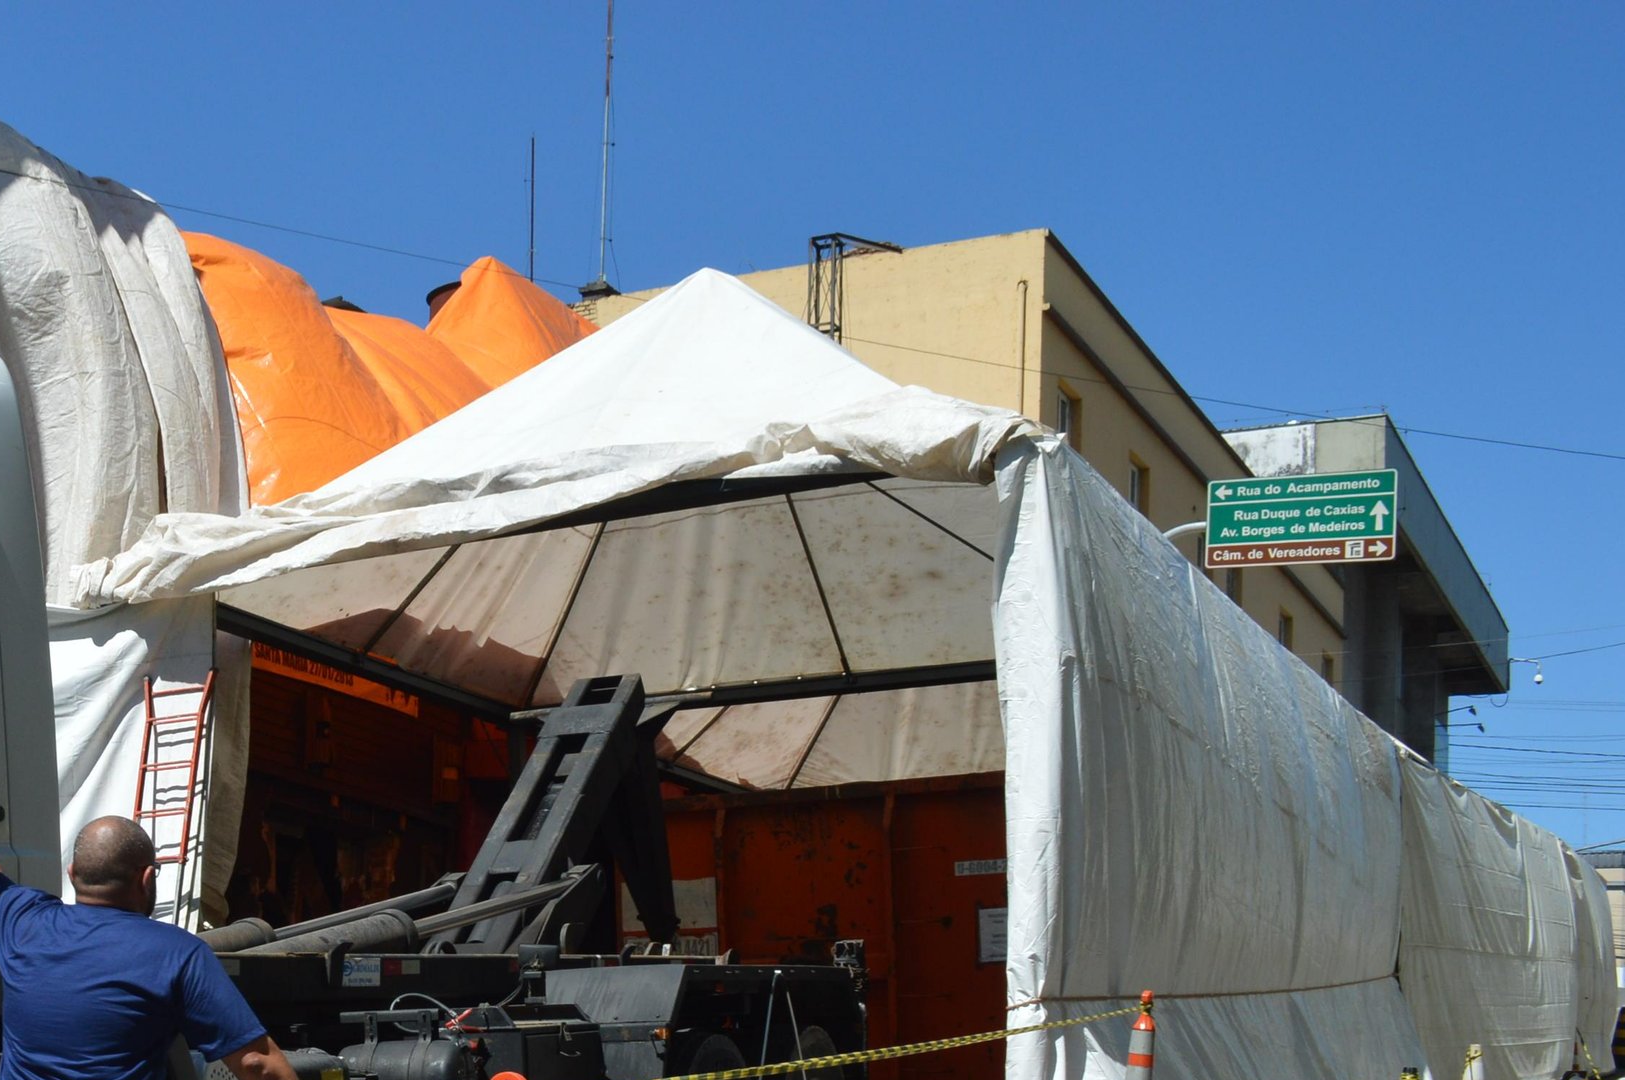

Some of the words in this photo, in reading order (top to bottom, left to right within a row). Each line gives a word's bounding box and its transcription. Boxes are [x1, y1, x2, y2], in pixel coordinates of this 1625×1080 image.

[1237, 486, 1261, 497] Rua
[1265, 483, 1281, 495] do
[1286, 478, 1380, 494] Acampamento
[1233, 510, 1261, 521] Rua
[1261, 508, 1301, 521] Duque
[1305, 506, 1321, 517] de
[1323, 504, 1365, 516] Caxias
[1220, 527, 1239, 538] Av.
[1241, 525, 1285, 538] Borges
[1290, 523, 1306, 534] de
[1309, 520, 1365, 533] Medeiros
[1213, 548, 1245, 561] Câm.
[1248, 548, 1264, 560] de
[1268, 545, 1341, 559] Vereadores
